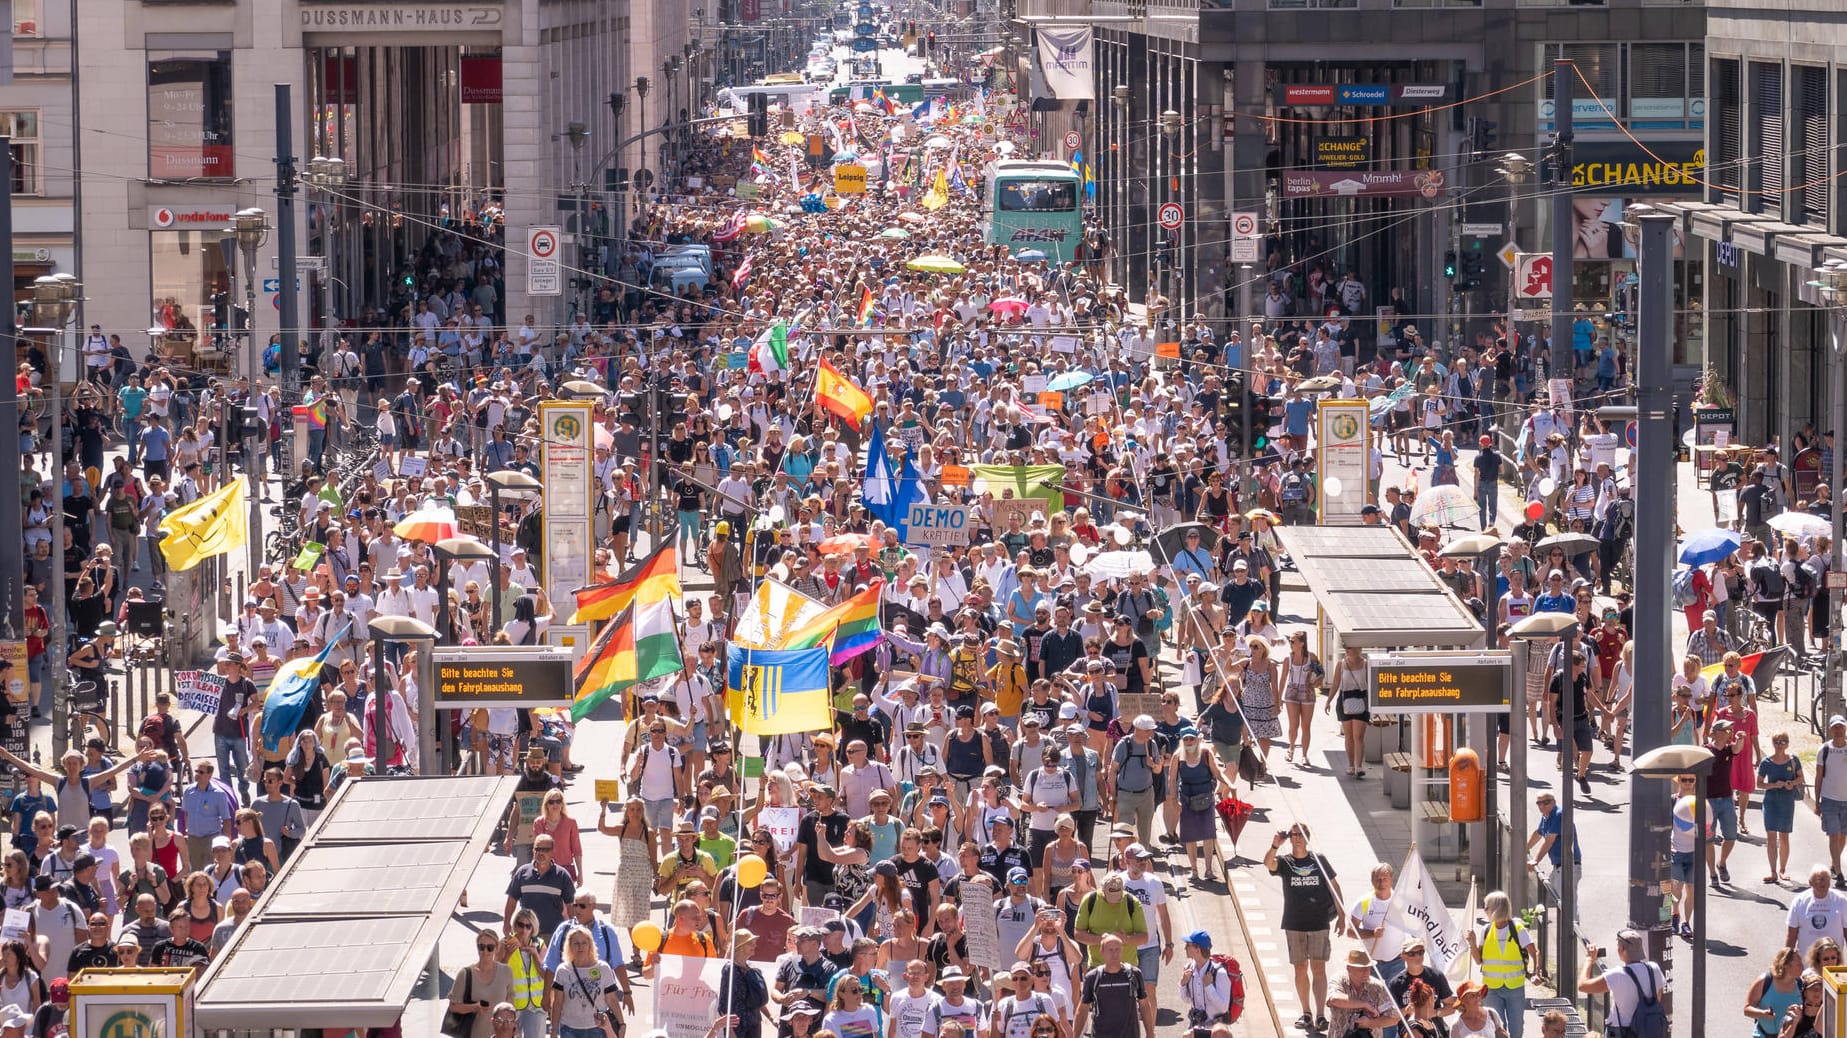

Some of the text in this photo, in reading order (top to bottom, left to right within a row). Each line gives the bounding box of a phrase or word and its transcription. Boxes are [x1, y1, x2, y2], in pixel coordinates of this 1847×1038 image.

[301, 9, 463, 25] DUSSMANN-HAUS
[1289, 88, 1330, 97] westermann
[1352, 91, 1385, 99] Schroedel
[1405, 88, 1441, 98] Diesterweg
[1068, 136, 1078, 145] 30
[166, 154, 218, 166] Dussmann
[838, 173, 864, 182] Leipzig
[1288, 176, 1311, 185] berlin
[1363, 174, 1402, 184] Mmmh!
[177, 211, 230, 222] vodafone
[1163, 210, 1179, 222] 30
[911, 507, 965, 529] DEMO
[923, 529, 966, 542] KRATIE!
[441, 667, 515, 679] Bitte beachten Sie
[1378, 671, 1452, 684] Bitte beachten Sie
[441, 682, 523, 696] den Fahrplanaushang
[1378, 687, 1461, 700] den Fahrplanaushang
[662, 983, 686, 996] Für
